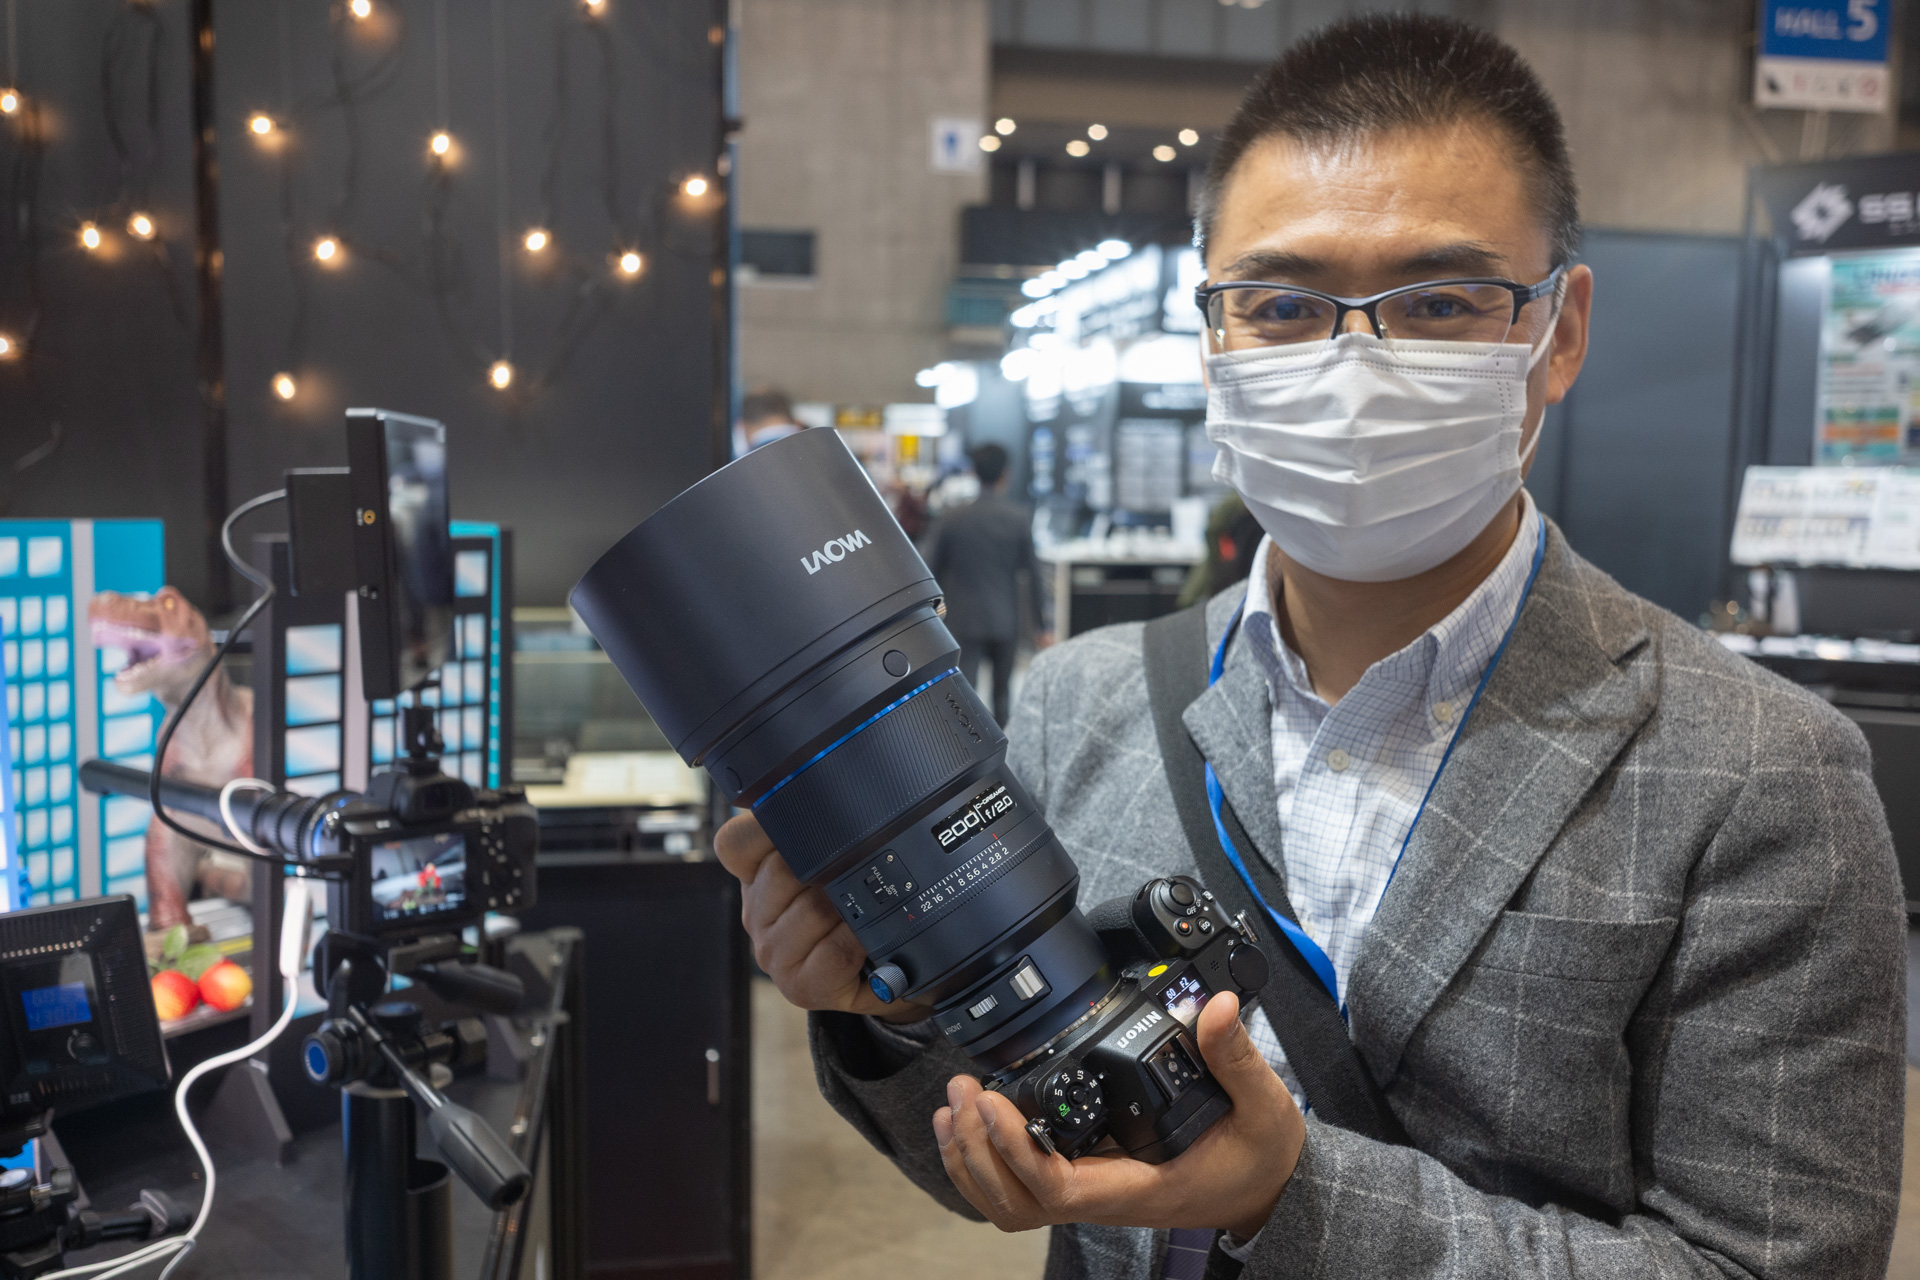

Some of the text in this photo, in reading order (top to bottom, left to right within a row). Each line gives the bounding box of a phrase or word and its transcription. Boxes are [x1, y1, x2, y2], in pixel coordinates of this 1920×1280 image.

[1847, 0, 1879, 42] 5
[800, 529, 872, 575] LAOWA
[938, 811, 980, 847] 200
[871, 866, 884, 881] FULL
[920, 846, 1010, 912] 22 16 11 8 5.6 4 2.8 2
[1186, 905, 1197, 915] OFF
[1165, 976, 1190, 1000] 60 F2
[1116, 1010, 1163, 1049] Nikon
[1061, 1072, 1071, 1084] U2
[1077, 1070, 1084, 1080] U3
[1089, 1079, 1098, 1088] M
[1094, 1097, 1101, 1105] A
[1088, 1112, 1095, 1120] S
